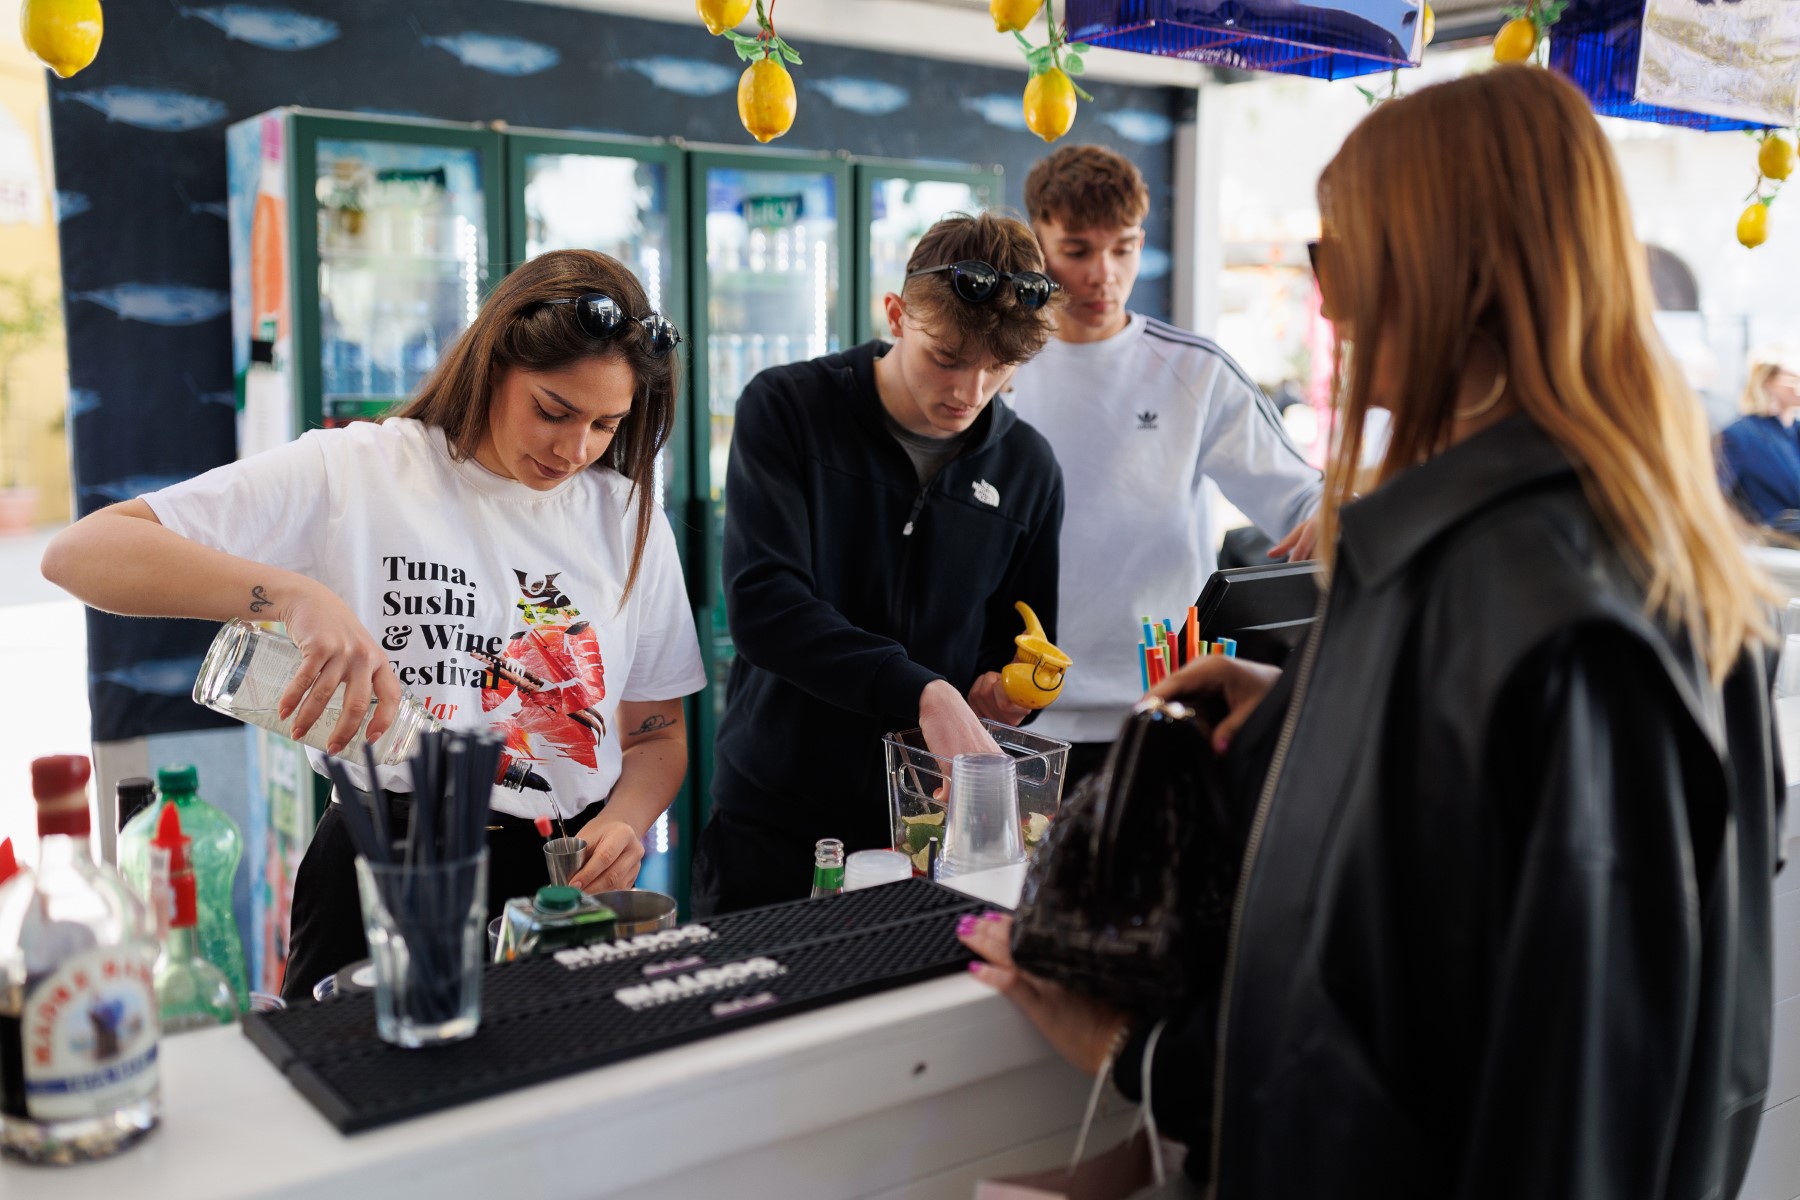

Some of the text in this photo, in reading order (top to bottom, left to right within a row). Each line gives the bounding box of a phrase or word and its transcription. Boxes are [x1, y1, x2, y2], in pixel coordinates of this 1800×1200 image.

[382, 556, 477, 589] Tuna,
[382, 588, 476, 618] Sushi
[381, 624, 503, 654] & Wine
